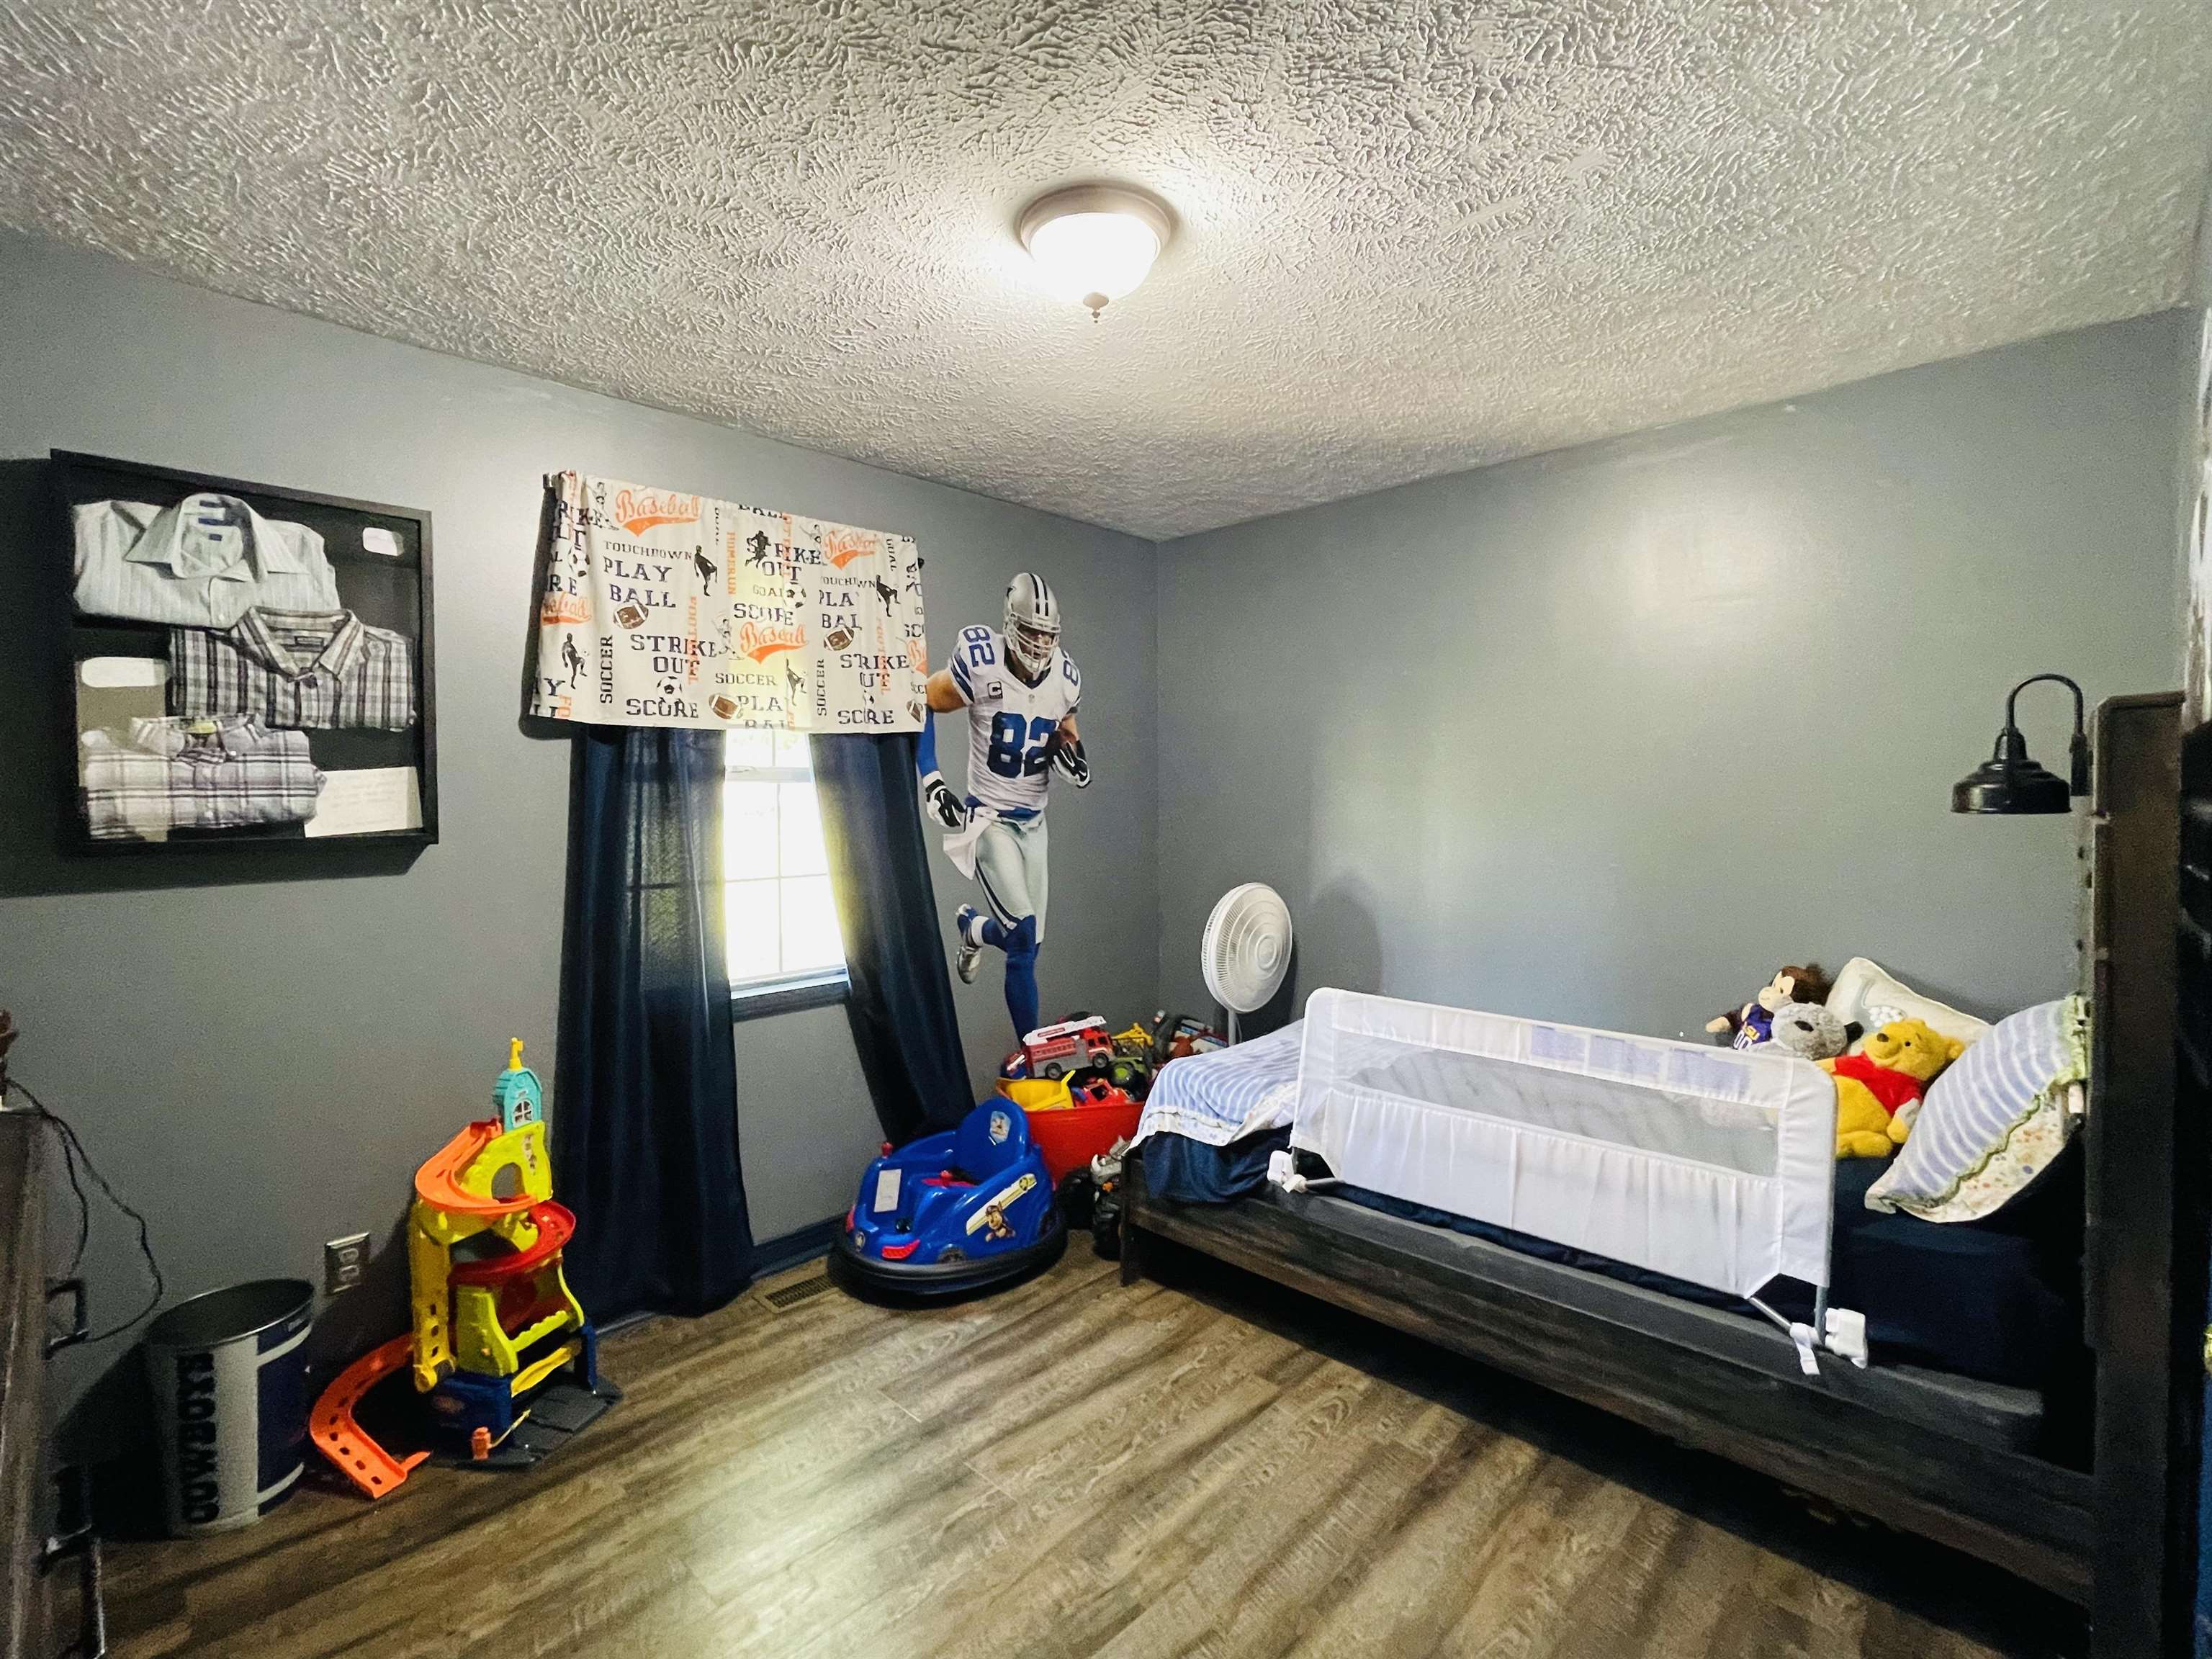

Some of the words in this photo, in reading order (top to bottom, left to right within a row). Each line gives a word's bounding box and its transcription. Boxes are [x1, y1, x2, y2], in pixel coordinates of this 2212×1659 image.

[616, 490, 700, 523] Baseball
[604, 541, 692, 560] TOUCHDOWN
[603, 556, 673, 583] PLAY
[609, 583, 676, 608] BALL
[630, 634, 718, 657] STRIKE
[963, 626, 995, 667] 82
[600, 635, 613, 703] SOCCER
[653, 656, 700, 677] OUT
[715, 673, 778, 686] SOCCER
[817, 659, 827, 716] SOCCER
[626, 696, 699, 719] SCORE
[987, 711, 1058, 778] 82
